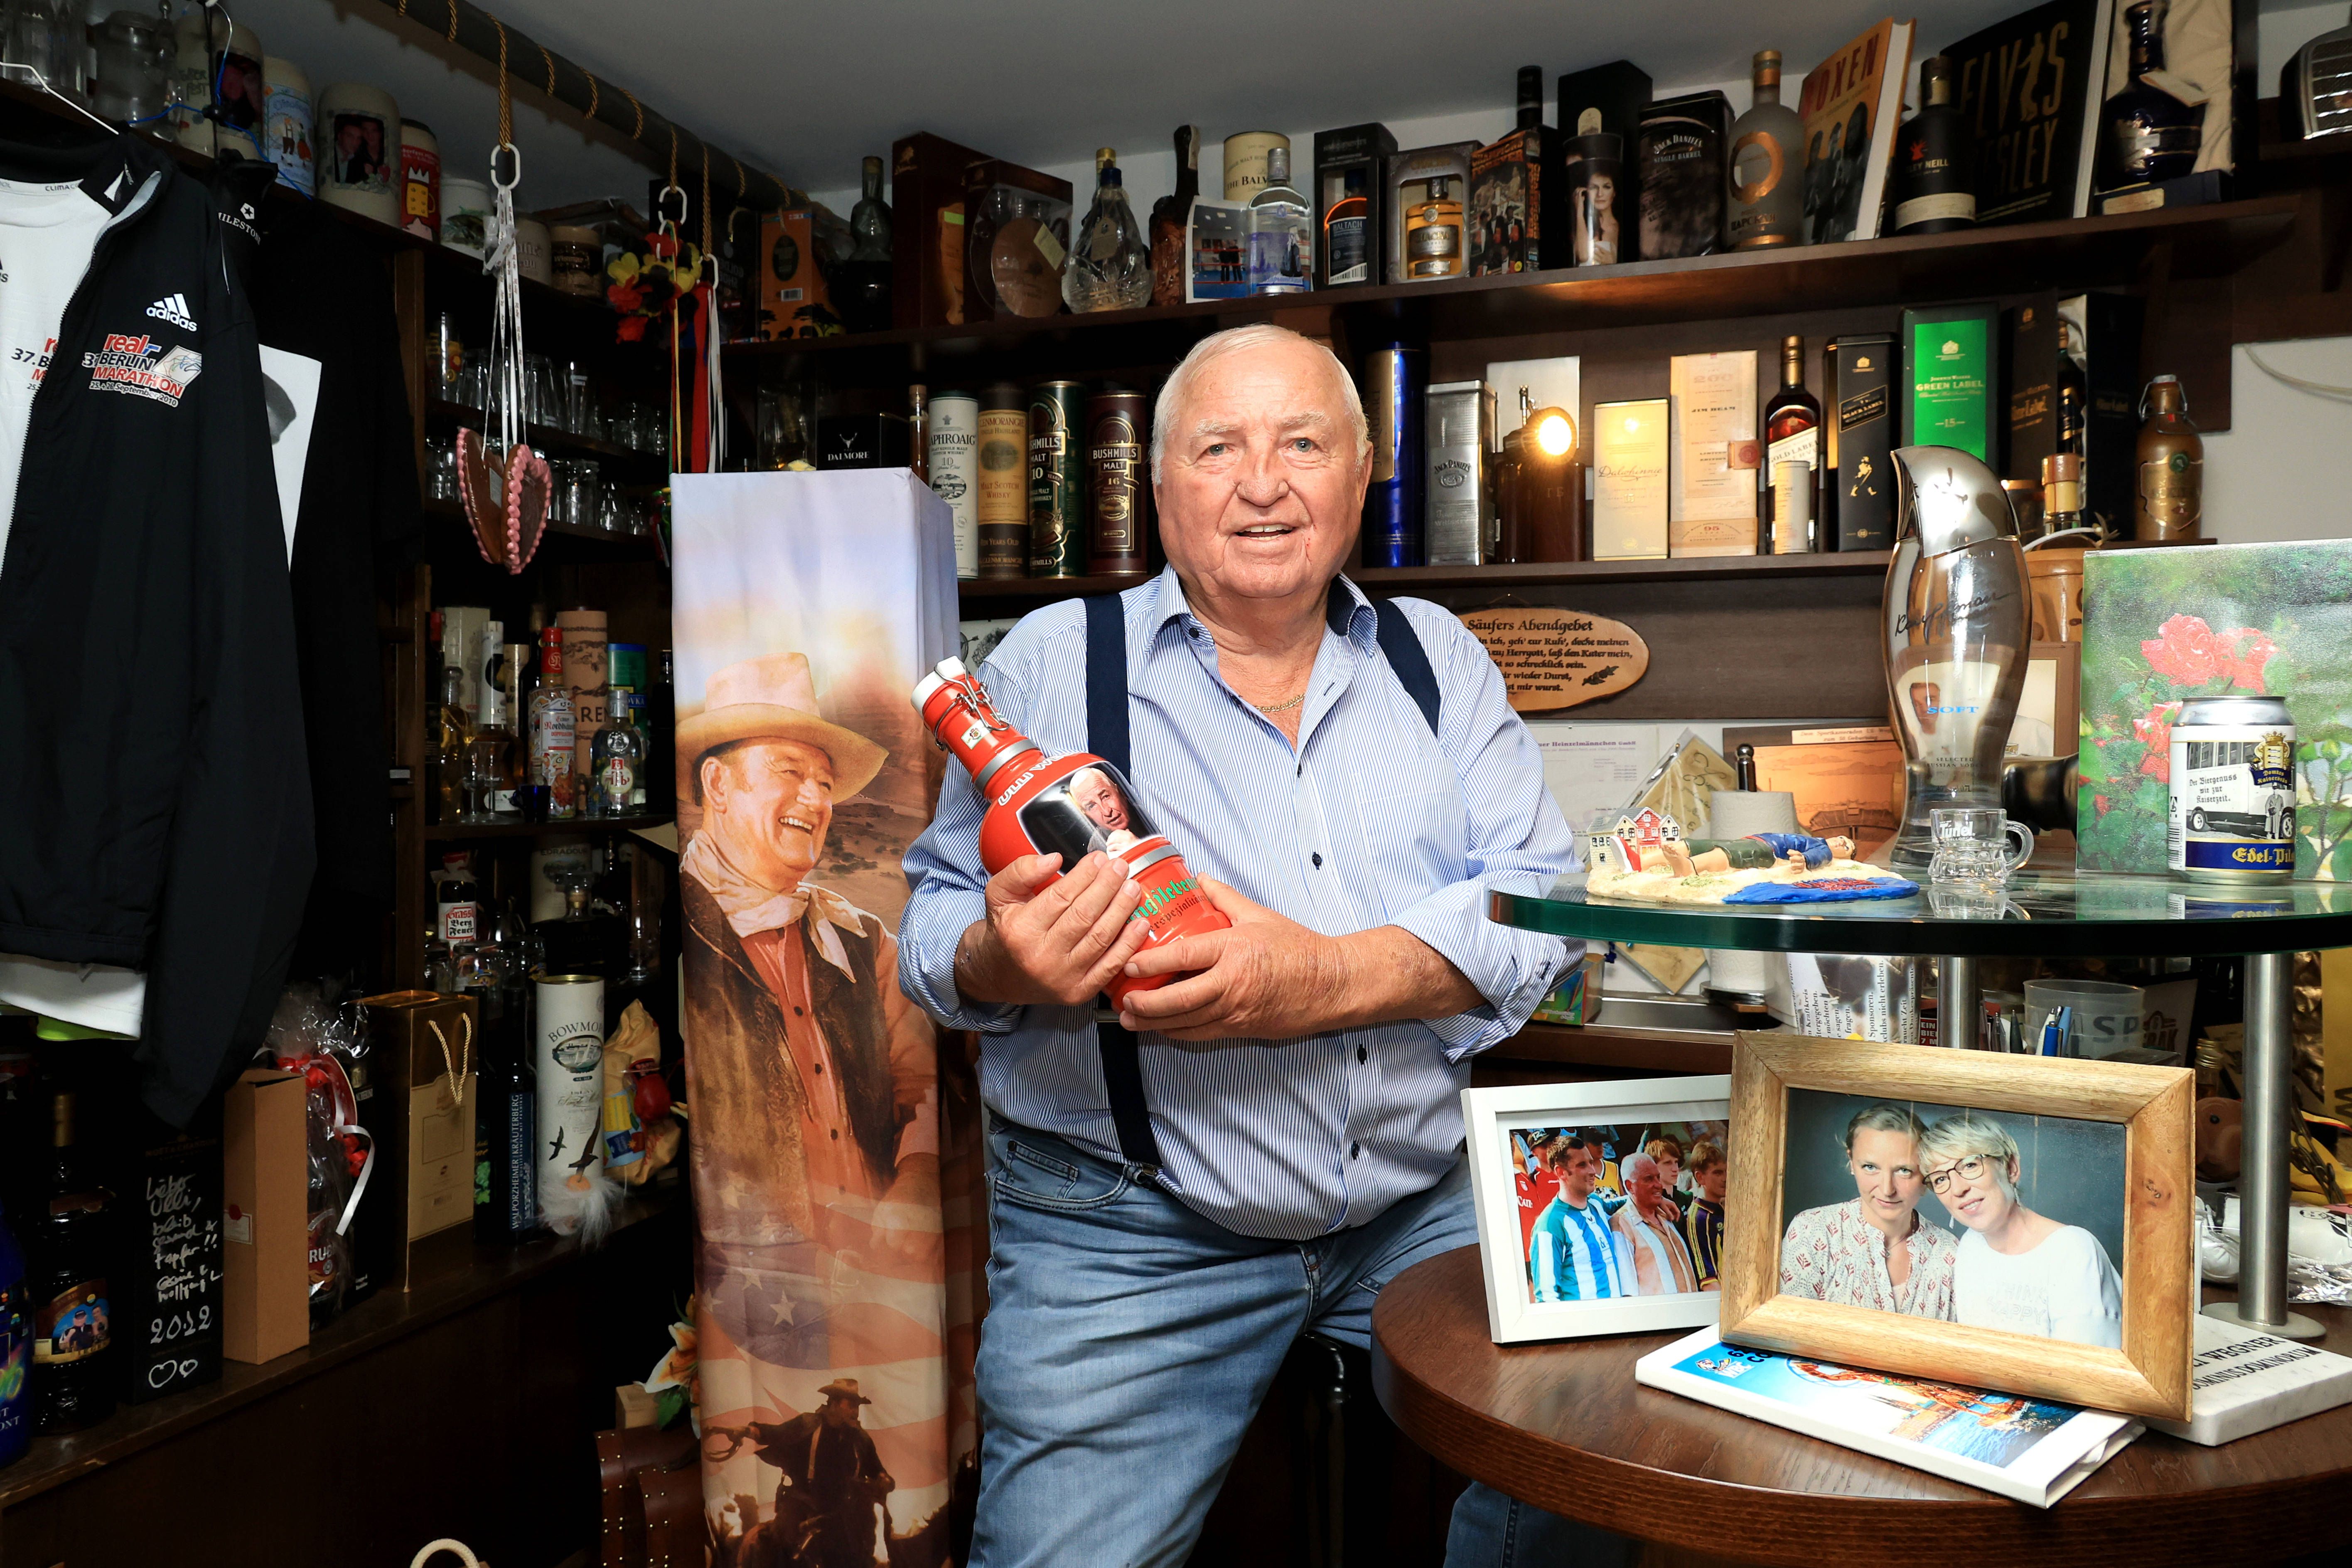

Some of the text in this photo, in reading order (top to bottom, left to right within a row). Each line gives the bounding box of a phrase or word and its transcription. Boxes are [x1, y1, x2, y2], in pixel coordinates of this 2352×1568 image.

[1925, 158, 1949, 168] NEILL
[1242, 176, 1268, 185] BALV
[218, 212, 261, 246] ILESTON
[146, 307, 197, 332] adidas
[98, 352, 155, 371] BERLIN
[93, 366, 185, 399] MARATHON
[1915, 380, 1984, 391] GREEN LABEL
[159, 394, 178, 407] 2010
[930, 433, 975, 446] APHROAIG
[828, 451, 870, 461] DALMORE
[1093, 448, 1137, 459] BUSHMILLS
[1032, 467, 1044, 480] 10
[1434, 462, 1448, 474] JACK
[1598, 465, 1662, 478] Dalwhinnie
[1108, 477, 1120, 485] 16
[1467, 619, 1593, 636] Säufers Abendgebet
[1506, 649, 1546, 660] Herrgott,
[1564, 649, 1579, 657] den
[1580, 649, 1606, 658] Kater
[1607, 650, 1632, 659] mein,
[1516, 659, 1564, 668] schrecklich
[1513, 671, 1542, 679] wieder
[1544, 672, 1572, 681] Durst,
[1927, 706, 1979, 715] SOFT
[2199, 774, 2237, 785] Biergenuss
[2212, 786, 2223, 794] zur
[2196, 795, 2231, 804] Kaiserzeit.
[1876, 961, 1885, 993] erleben.
[1803, 989, 1811, 1028] Kraftkreis
[1878, 995, 1887, 1016] nicht
[1900, 999, 1908, 1016] Zeit
[1812, 990, 1823, 1037] itergegeben.
[1823, 1000, 1831, 1034] möchten
[1834, 1007, 1843, 1032] sagen.
[1844, 1006, 1853, 1034] fragen.
[1867, 992, 1878, 1038] Sponsoren.
[511, 1158, 520, 1229] WALPORZHEIMER
[2200, 1336, 2288, 1361] WEGNER
[2242, 1347, 2322, 1375] DOMINORUM
